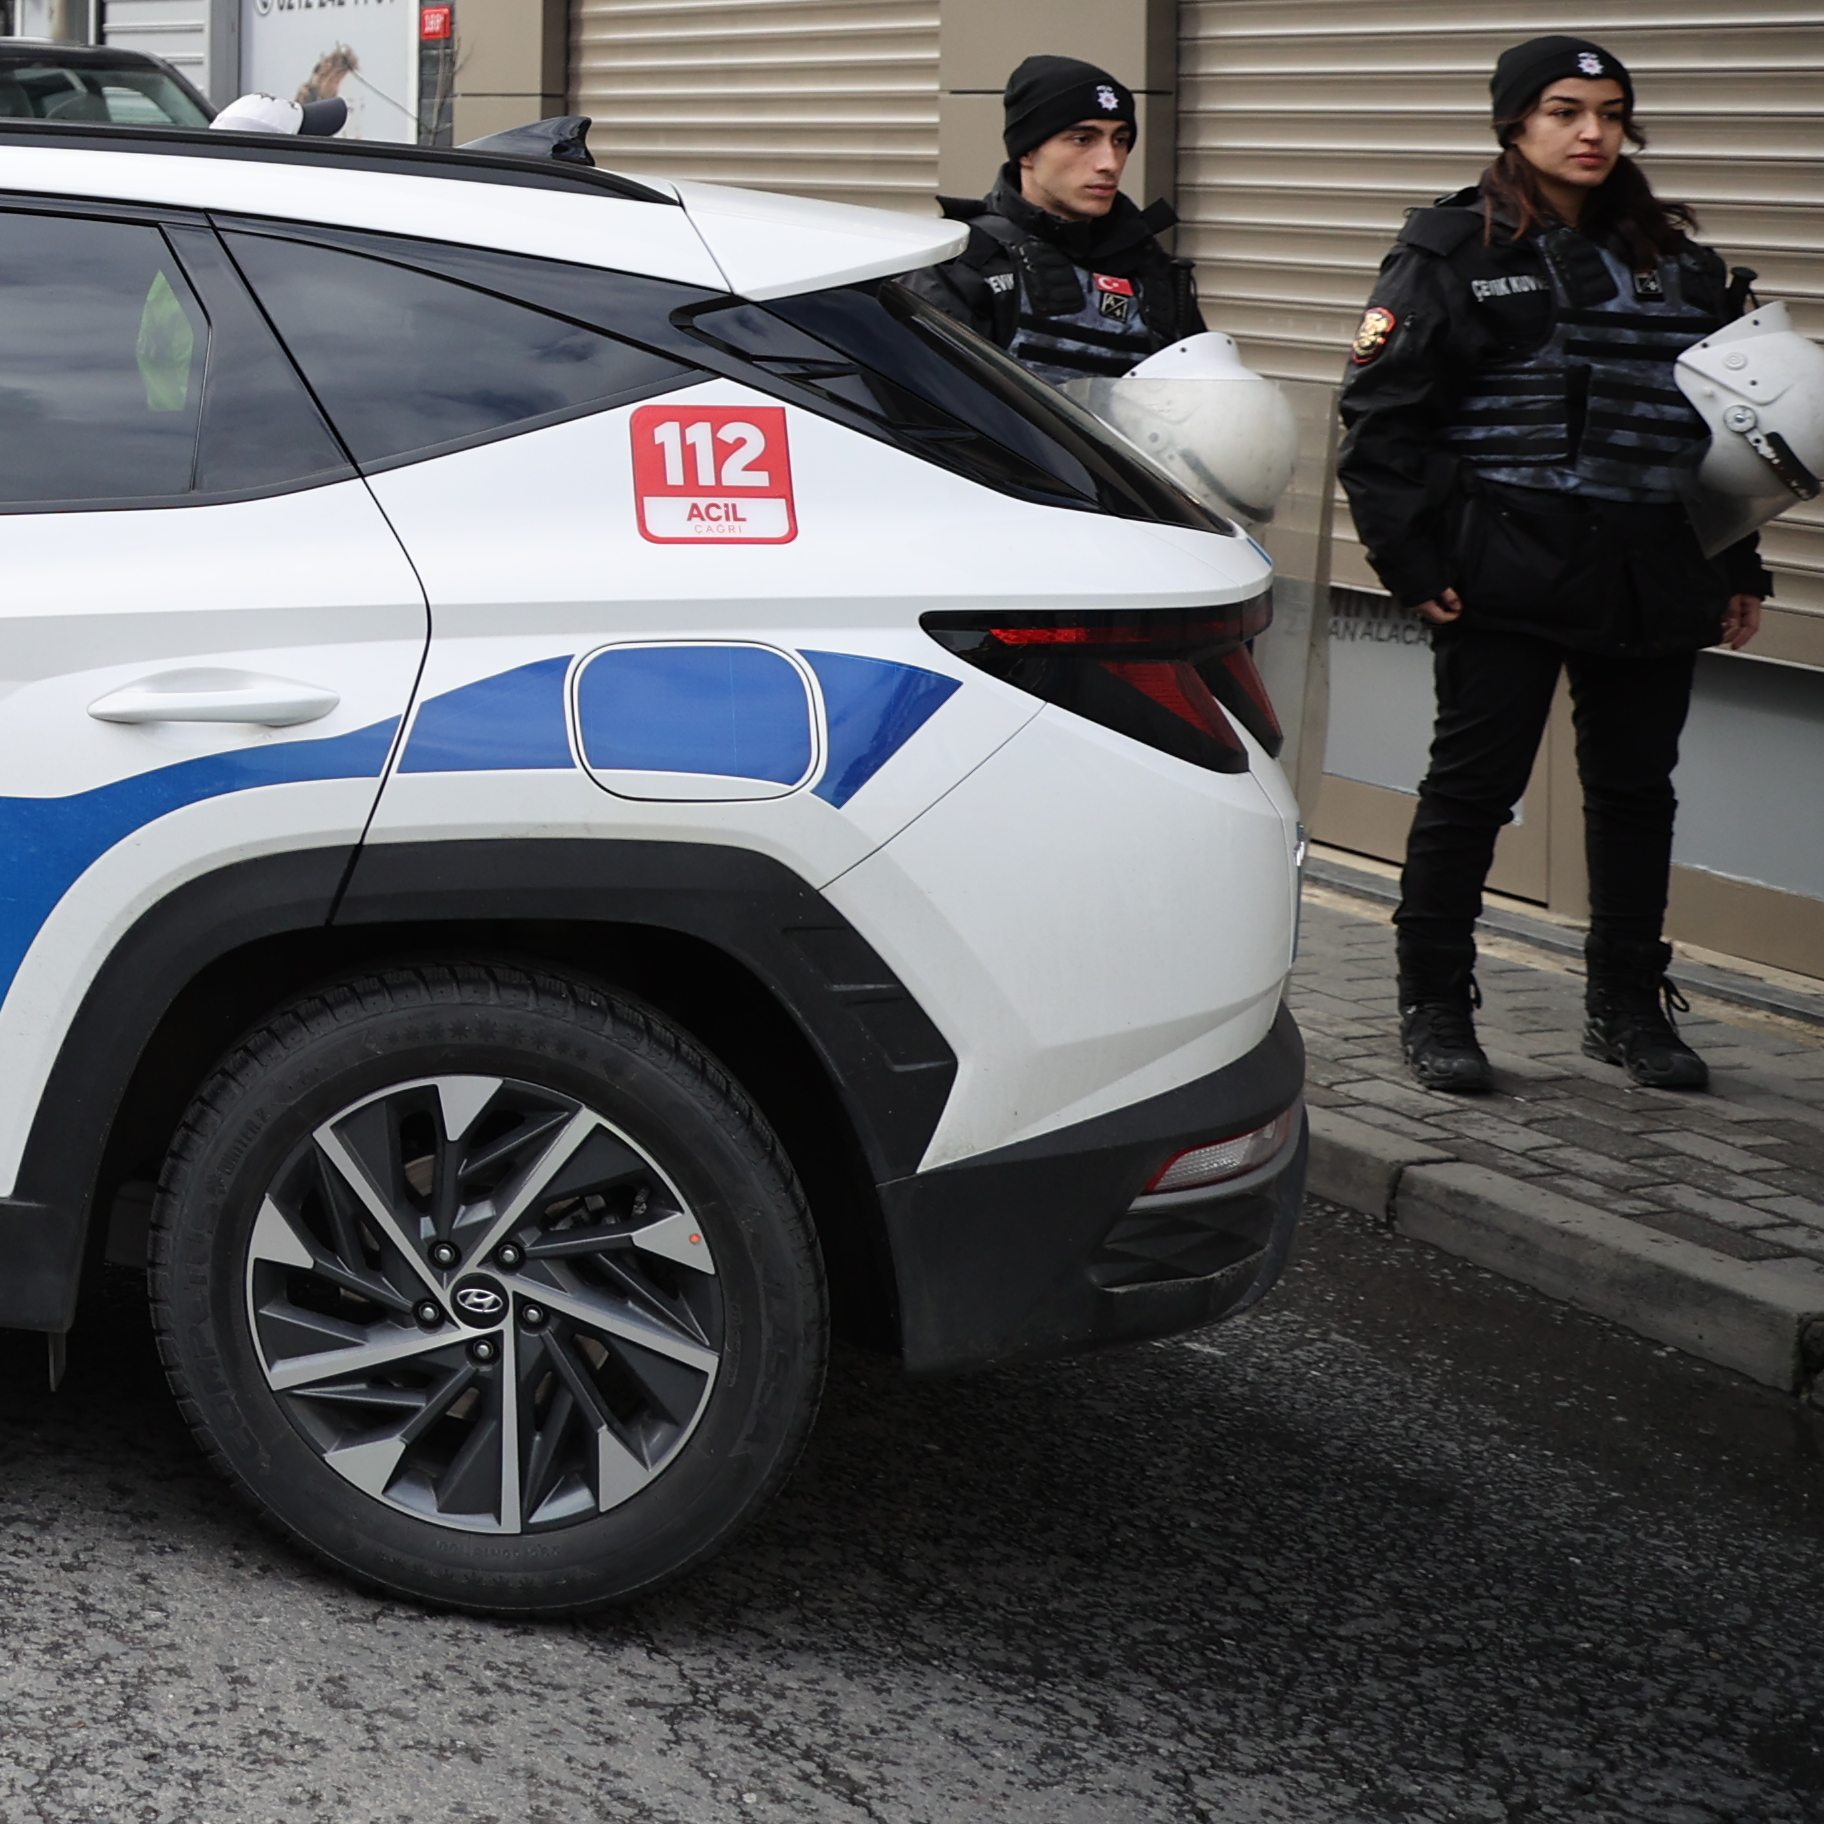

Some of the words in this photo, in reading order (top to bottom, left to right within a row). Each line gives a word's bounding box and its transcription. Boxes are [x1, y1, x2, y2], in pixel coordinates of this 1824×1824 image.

[654, 421, 771, 487] 112
[686, 502, 747, 522] ACİL
[694, 524, 743, 535] ÇAĞRI
